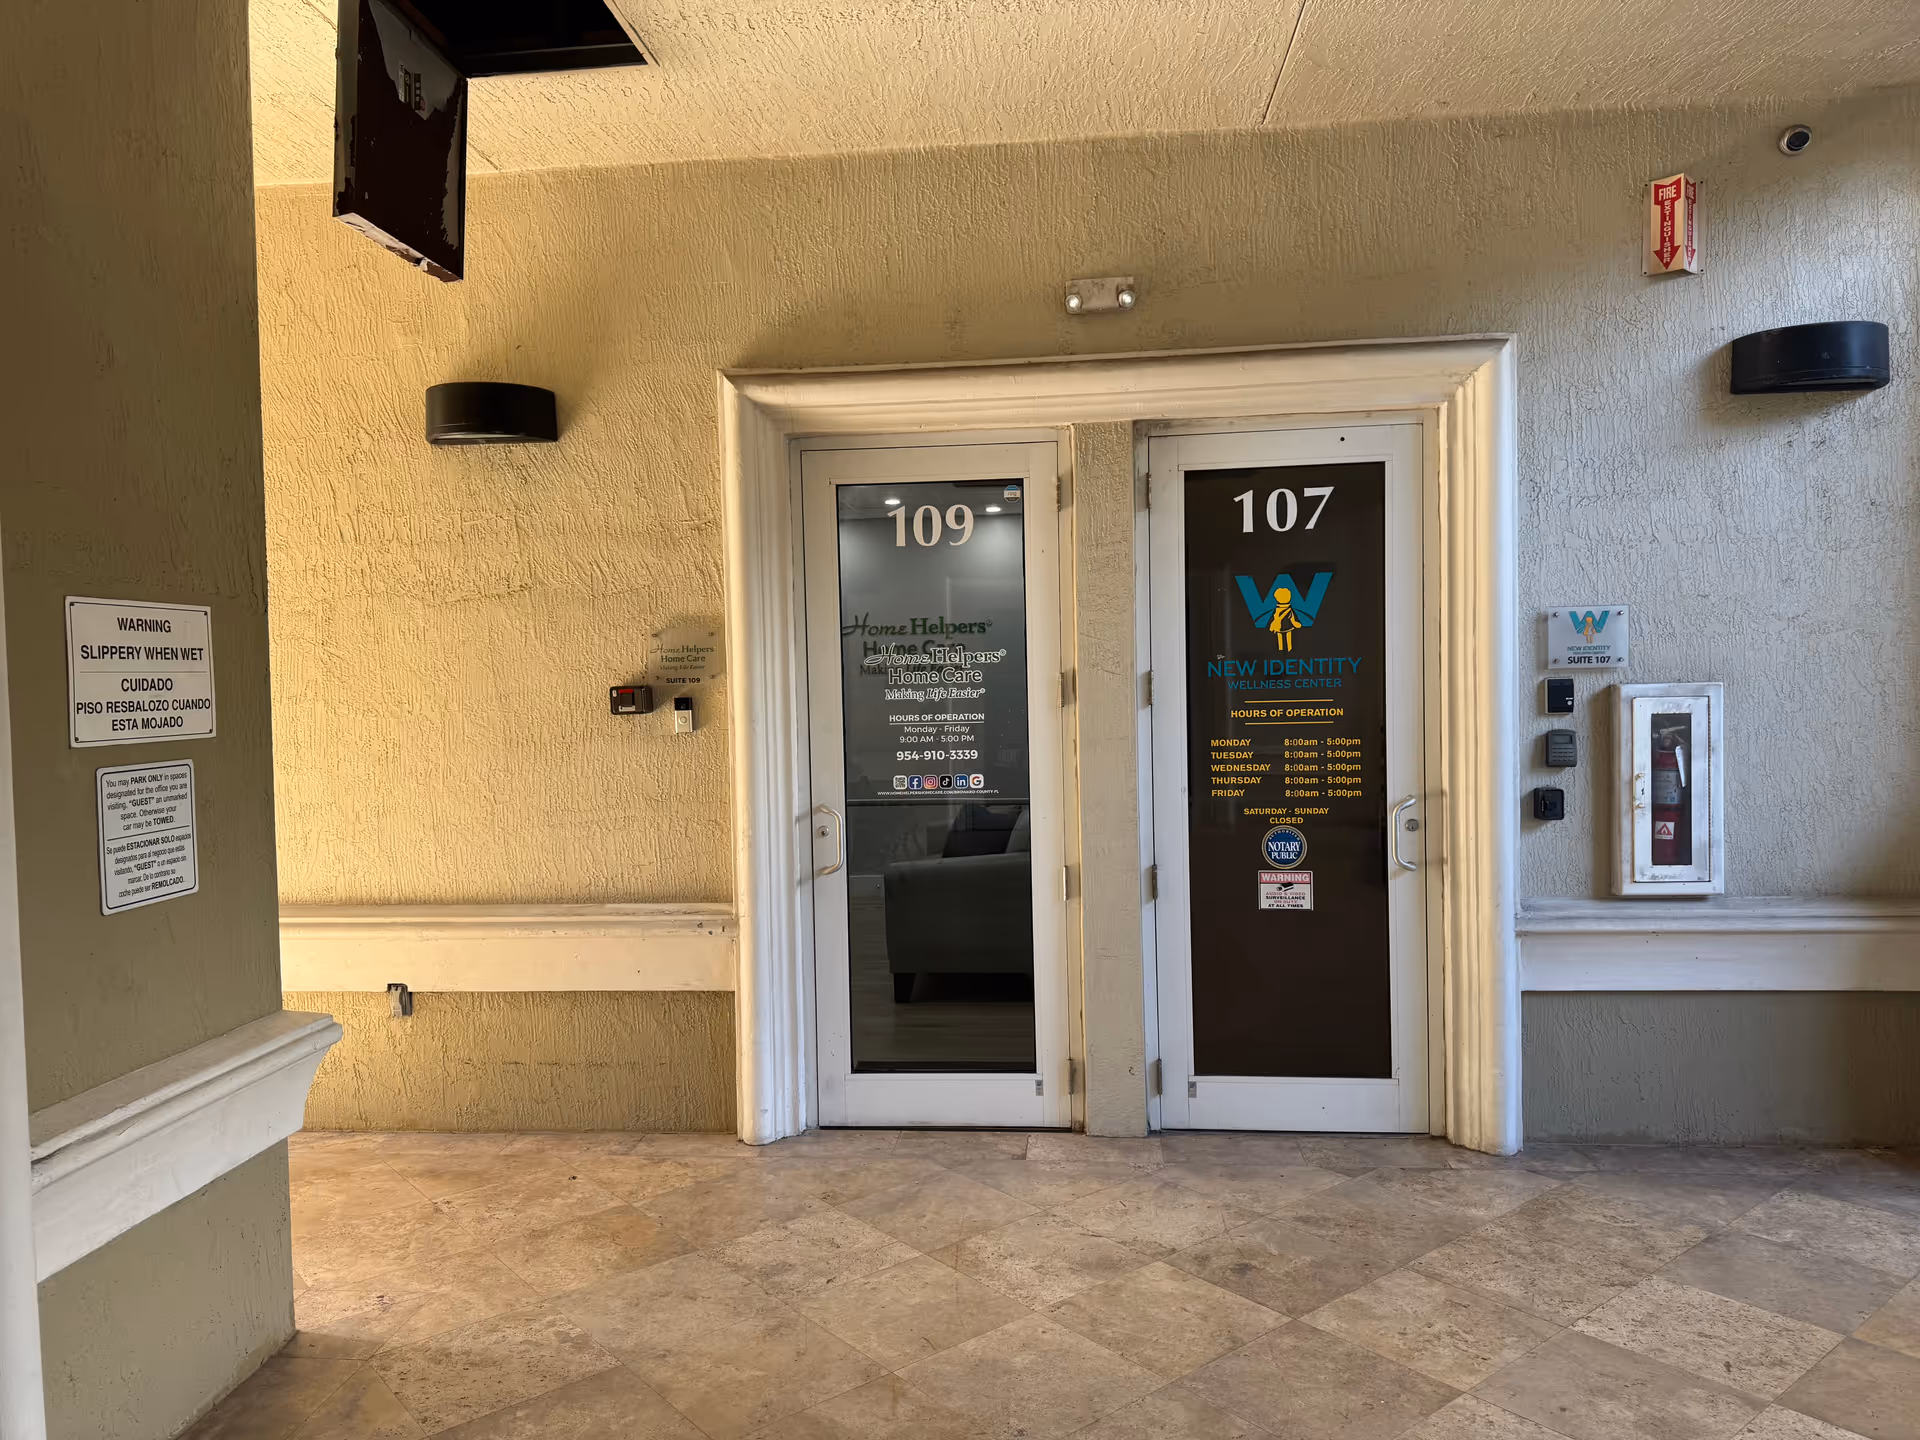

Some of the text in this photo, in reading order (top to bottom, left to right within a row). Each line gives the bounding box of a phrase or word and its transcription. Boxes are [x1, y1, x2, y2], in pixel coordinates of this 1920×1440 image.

[1659, 185, 1677, 201] FIRE
[1233, 486, 1335, 533] 107
[887, 504, 974, 547] 109
[117, 617, 171, 633] WARNING
[80, 645, 204, 661] SLIPPERY WHEN WET
[649, 644, 714, 655] Home Helpers
[864, 642, 930, 666] Home
[1568, 656, 1611, 664] SUITE 107
[1208, 657, 1362, 677] NEW IDENTITY
[889, 668, 938, 684] Home
[942, 668, 982, 683] Care
[121, 678, 173, 692] CUIDADO
[1227, 678, 1342, 690] WELLNESS CENTER
[885, 689, 925, 702] Making
[926, 688, 948, 702] Life
[76, 698, 211, 715] PISO RESBALOZO CUANDO
[889, 714, 920, 722] HOURS
[934, 713, 985, 721] OPERATION
[1231, 708, 1344, 718] HOURS OF OPERATION
[112, 716, 183, 731] ESTA MOJADO
[904, 726, 937, 734] Monday
[944, 725, 970, 734] Friday
[900, 736, 918, 744] 9:00
[961, 734, 975, 742] PM
[1210, 739, 1251, 747] MONDAY
[1284, 738, 1318, 746] 8:00am
[1327, 738, 1361, 748] 5:00pm
[896, 750, 978, 761] 954-910-3339
[1211, 751, 1254, 759] TUESDAY
[1284, 750, 1318, 759] 8:00am
[1327, 750, 1361, 761] 5:00pm
[1211, 764, 1271, 772] WEDNESDAY
[1284, 764, 1318, 772] 8:00am
[1327, 763, 1361, 773] 5:00pm
[106, 780, 116, 788] You
[118, 779, 129, 788] may
[131, 775, 147, 785] PARK
[148, 774, 163, 783] ONLY
[170, 772, 188, 780] spaces
[1284, 776, 1318, 785] 8:00am
[1327, 776, 1362, 786] 5:00pm
[106, 788, 137, 799] designated
[137, 787, 145, 795] for
[145, 786, 154, 794] the
[155, 784, 168, 793] office
[170, 784, 179, 792] you
[163, 792, 188, 803] unmarked
[1285, 790, 1319, 798] 8:00am
[1328, 789, 1362, 799] 5:00pm
[139, 808, 165, 817] Otherwise
[166, 805, 177, 815] your
[133, 822, 144, 830] may
[153, 815, 176, 826] TOWED.
[106, 847, 113, 855] Se
[113, 844, 126, 855] puede
[126, 838, 160, 851] ESTACIONAR
[160, 835, 175, 844] SOLO
[1268, 842, 1301, 852] NOTARY
[114, 854, 138, 865] designados
[138, 852, 148, 861] para
[152, 848, 167, 858] negocio
[166, 857, 181, 866] espacio
[1271, 852, 1298, 860] PUBLIC
[143, 873, 150, 881] De
[1262, 873, 1309, 882] WARNING
[119, 889, 131, 898] coche
[131, 886, 144, 896] puede
